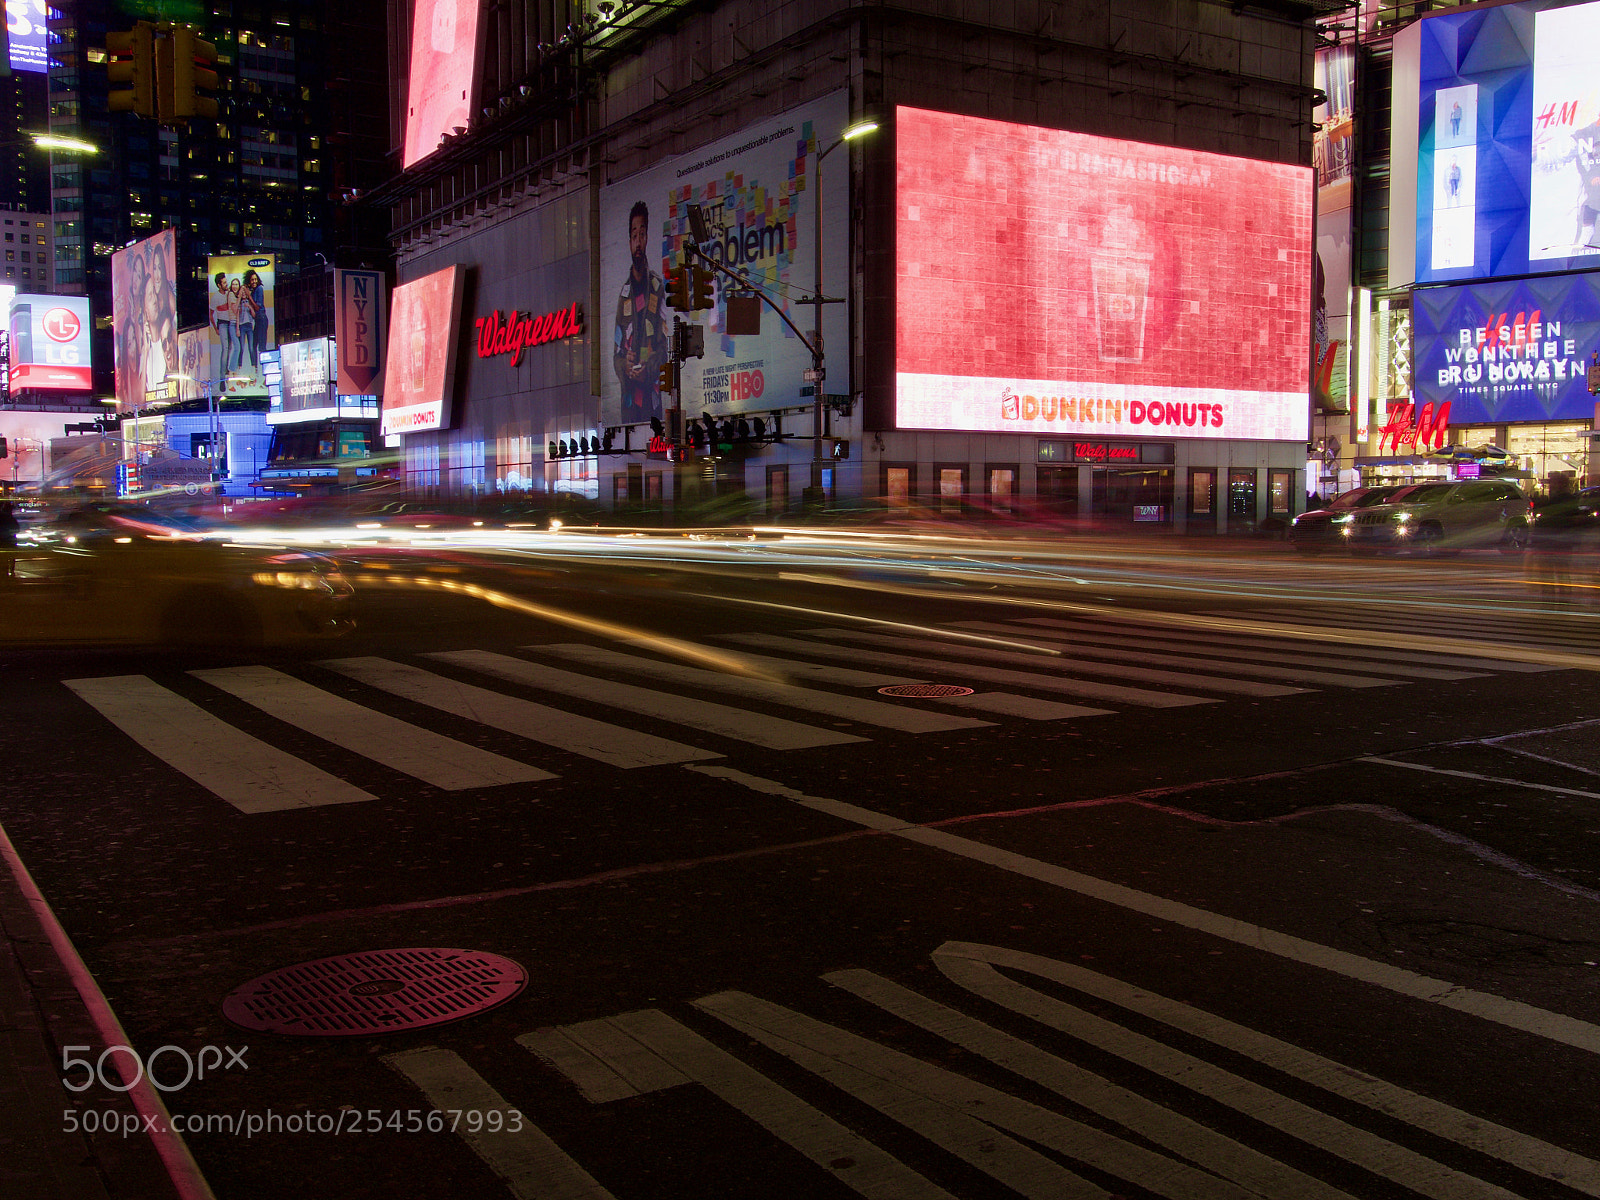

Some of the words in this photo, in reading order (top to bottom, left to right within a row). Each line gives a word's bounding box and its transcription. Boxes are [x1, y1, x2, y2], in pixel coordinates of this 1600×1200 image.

[1536, 100, 1578, 129] H&M
[677, 163, 704, 178] Questionable
[705, 154, 725, 167] solutions
[731, 136, 768, 156] unquestionable
[769, 126, 795, 142] problems.
[353, 277, 368, 365] NYPD
[1459, 327, 1487, 344] BE
[1499, 321, 1560, 341] SEEN
[475, 301, 580, 367] Walgreens
[45, 343, 79, 364] LG
[715, 366, 724, 374] LATE
[737, 359, 764, 371] PERSPECTIVE
[703, 374, 729, 389] FRIDAYS
[730, 369, 765, 401] HBO
[1459, 386, 1488, 394] TIMES
[1493, 383, 1533, 392] SQUARE
[1538, 382, 1558, 390] NYC
[703, 390, 729, 404] 11:30PM
[413, 410, 435, 425] DONUTS
[1129, 399, 1224, 428] DONUTS
[1378, 401, 1452, 451] H&M
[1075, 443, 1137, 462] Walgreens
